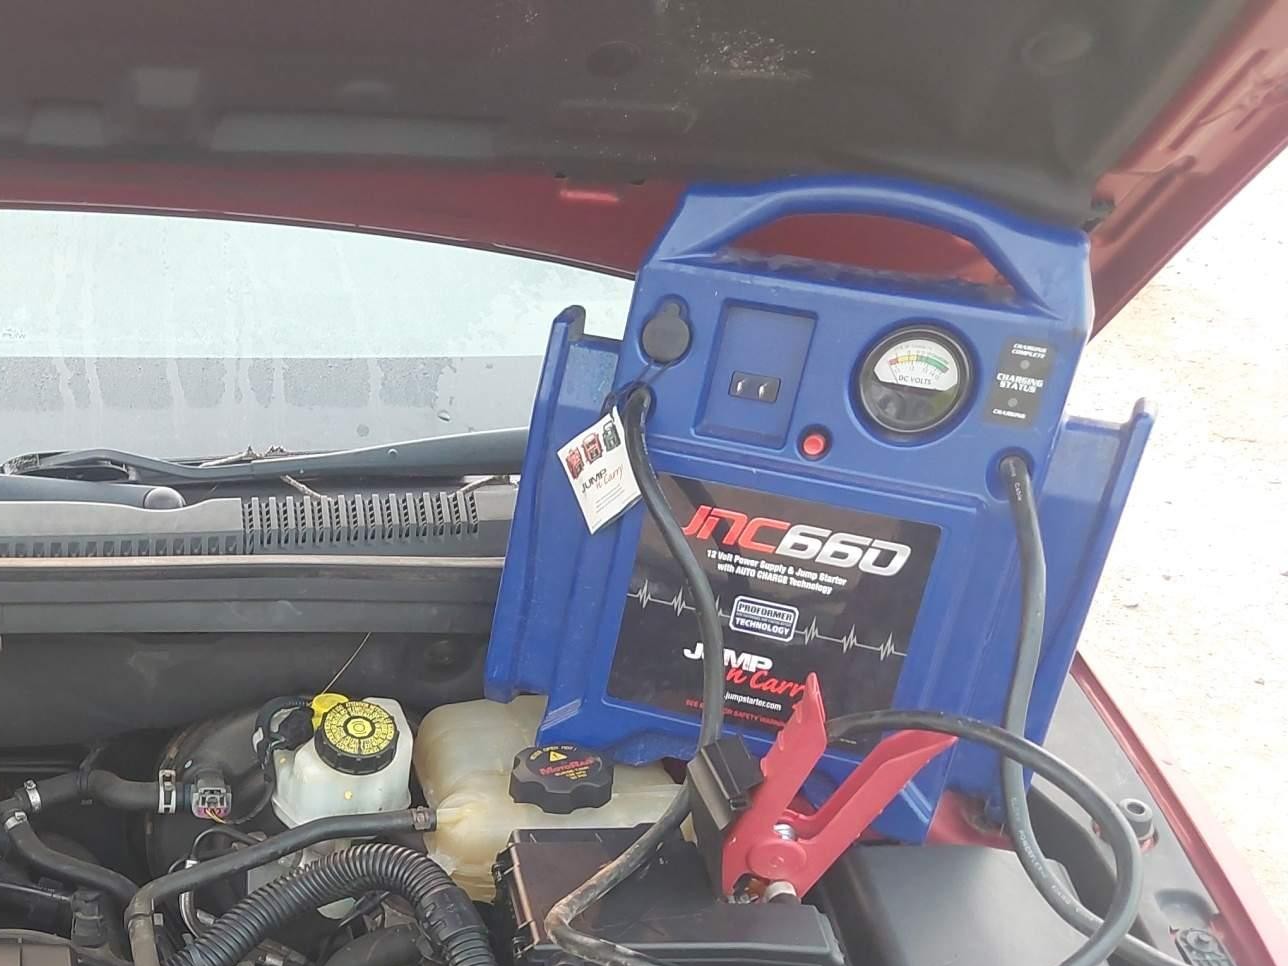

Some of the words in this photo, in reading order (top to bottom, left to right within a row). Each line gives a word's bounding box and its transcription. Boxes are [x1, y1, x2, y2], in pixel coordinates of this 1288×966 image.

[910, 376, 932, 385] VOLTS
[996, 372, 1044, 388] CHARGING
[999, 380, 1037, 393] STATUS
[581, 468, 607, 494] JUMP
[707, 549, 716, 559] 12
[717, 551, 733, 562] Volt
[734, 554, 759, 568] Power
[759, 560, 787, 575] Supply
[787, 566, 794, 575] &
[795, 568, 818, 581] Jump
[818, 572, 848, 586] Starter
[717, 563, 735, 573] with
[735, 566, 755, 578] AUTO
[757, 571, 788, 585] CHARGE
[789, 577, 833, 596] Technology
[738, 602, 793, 621] PROFORMER
[735, 617, 790, 636] TECHNOLOGY
[683, 642, 773, 672] JMP
[749, 670, 806, 697] Carr
